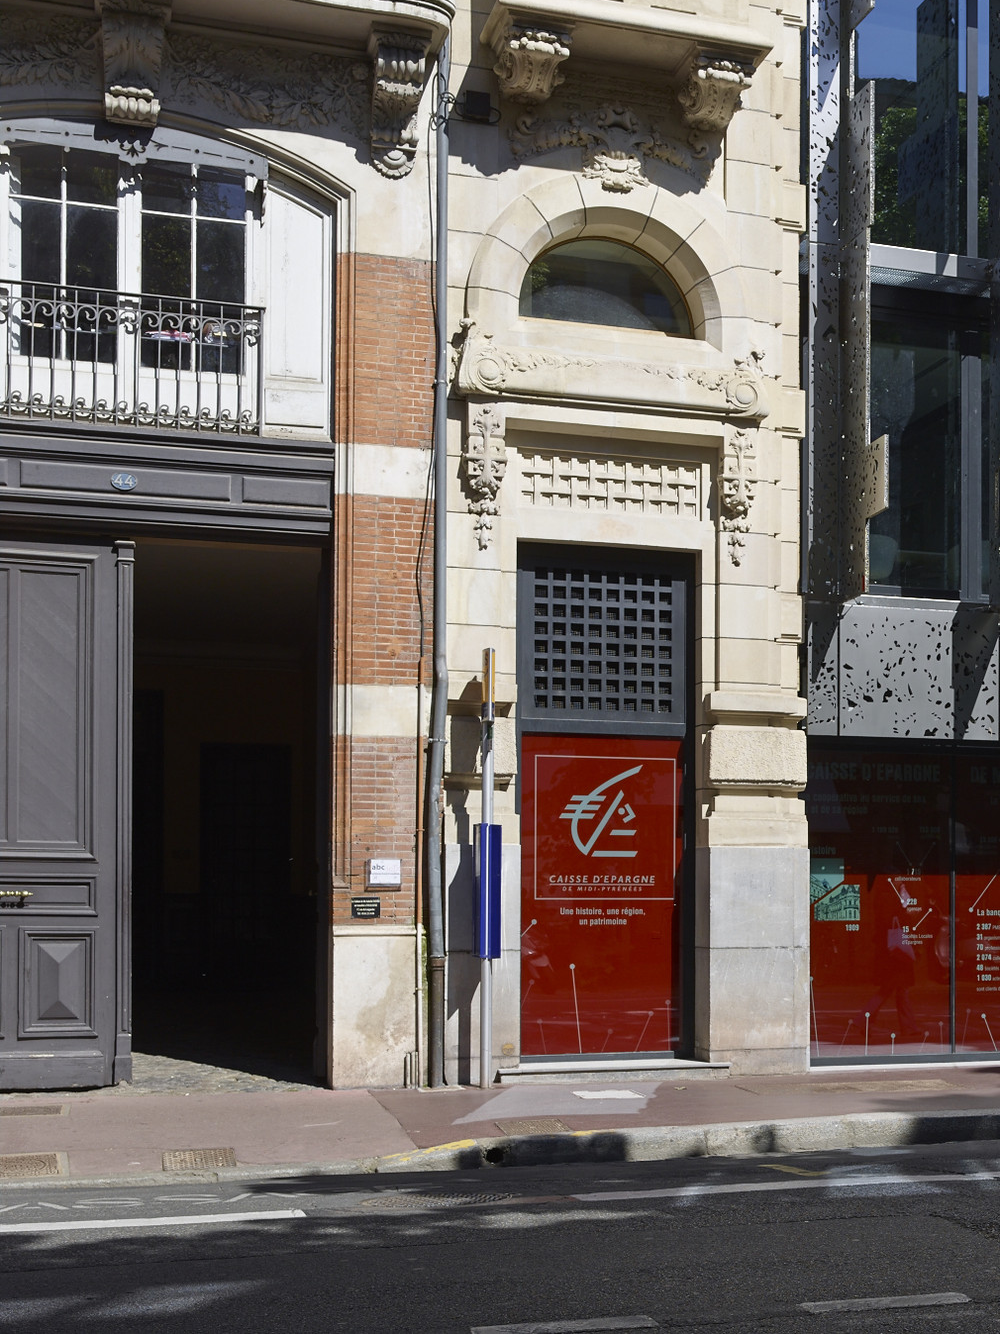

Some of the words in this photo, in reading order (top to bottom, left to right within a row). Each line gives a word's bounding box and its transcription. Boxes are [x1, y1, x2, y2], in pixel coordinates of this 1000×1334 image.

[114, 474, 134, 487] 44
[549, 875, 589, 884] CAISSE
[592, 875, 656, 884] D'EPARGNE
[560, 907, 574, 915] Une
[575, 907, 605, 916] histoire,
[621, 907, 646, 917] région,
[976, 908, 985, 916] La
[589, 918, 627, 927] patrimoine
[902, 925, 910, 933] 15
